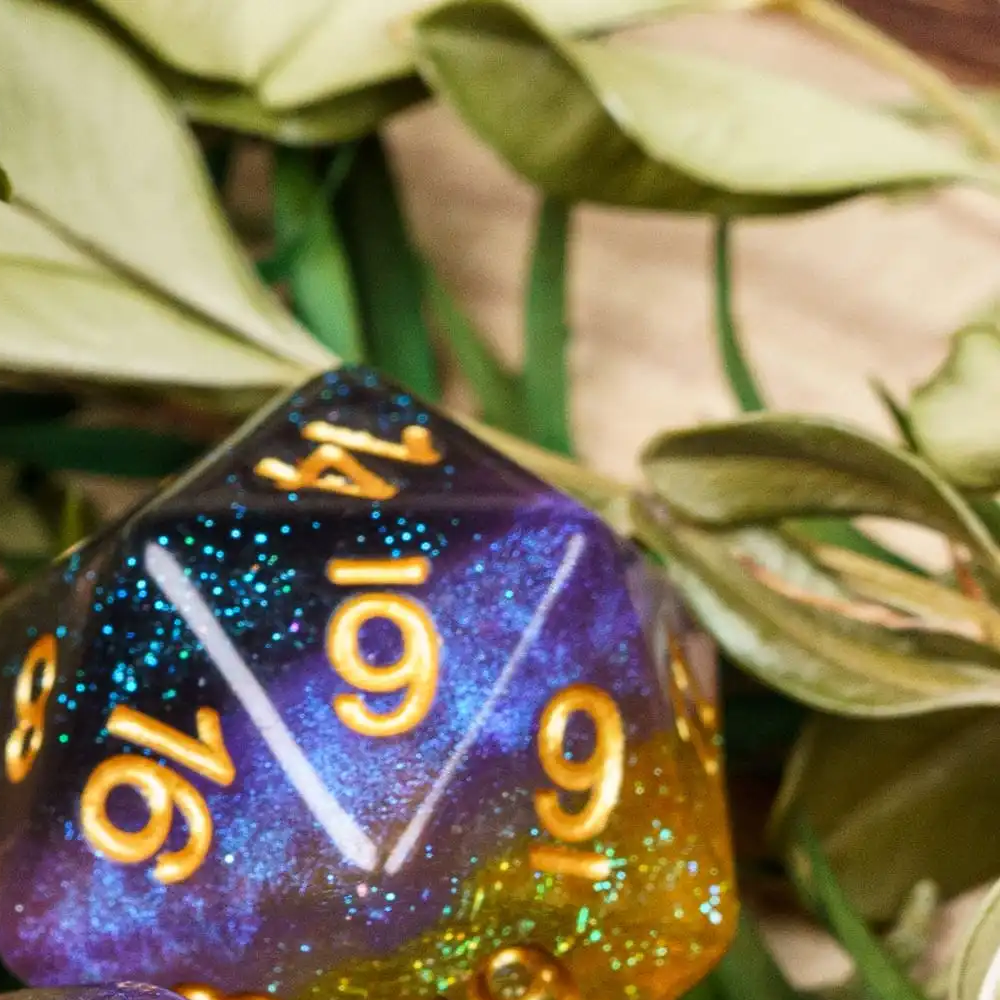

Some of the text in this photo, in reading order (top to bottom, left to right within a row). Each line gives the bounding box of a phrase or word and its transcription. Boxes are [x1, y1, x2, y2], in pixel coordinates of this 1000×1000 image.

[253, 420, 443, 500] 14
[4, 633, 57, 784] 8
[80, 703, 236, 883] 16
